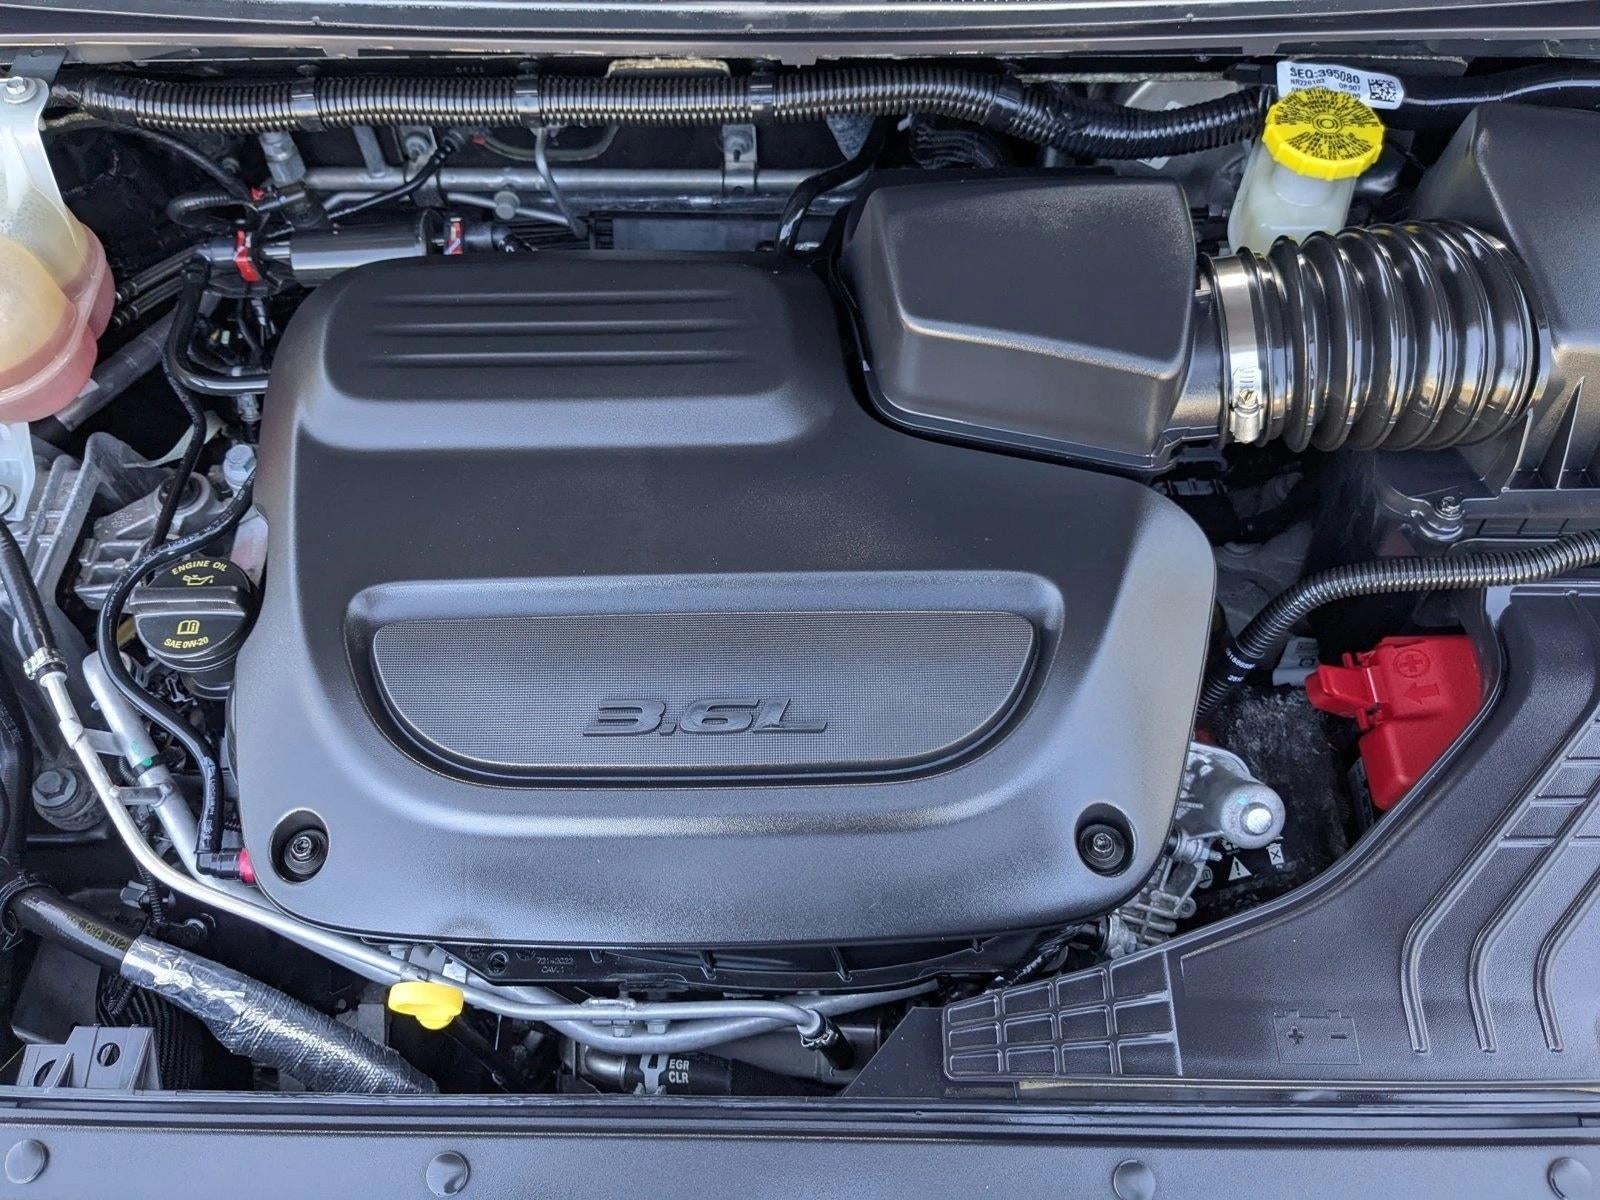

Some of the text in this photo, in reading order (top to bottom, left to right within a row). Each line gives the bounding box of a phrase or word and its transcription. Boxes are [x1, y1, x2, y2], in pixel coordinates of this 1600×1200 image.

[1290, 67, 1360, 84] SEQ:395080
[171, 560, 228, 575] ENGINE OIL
[164, 637, 209, 649] SAE 0W-20
[583, 698, 828, 736] 3.6L
[669, 1059, 690, 1070] EGR
[668, 1071, 689, 1083] CLR
